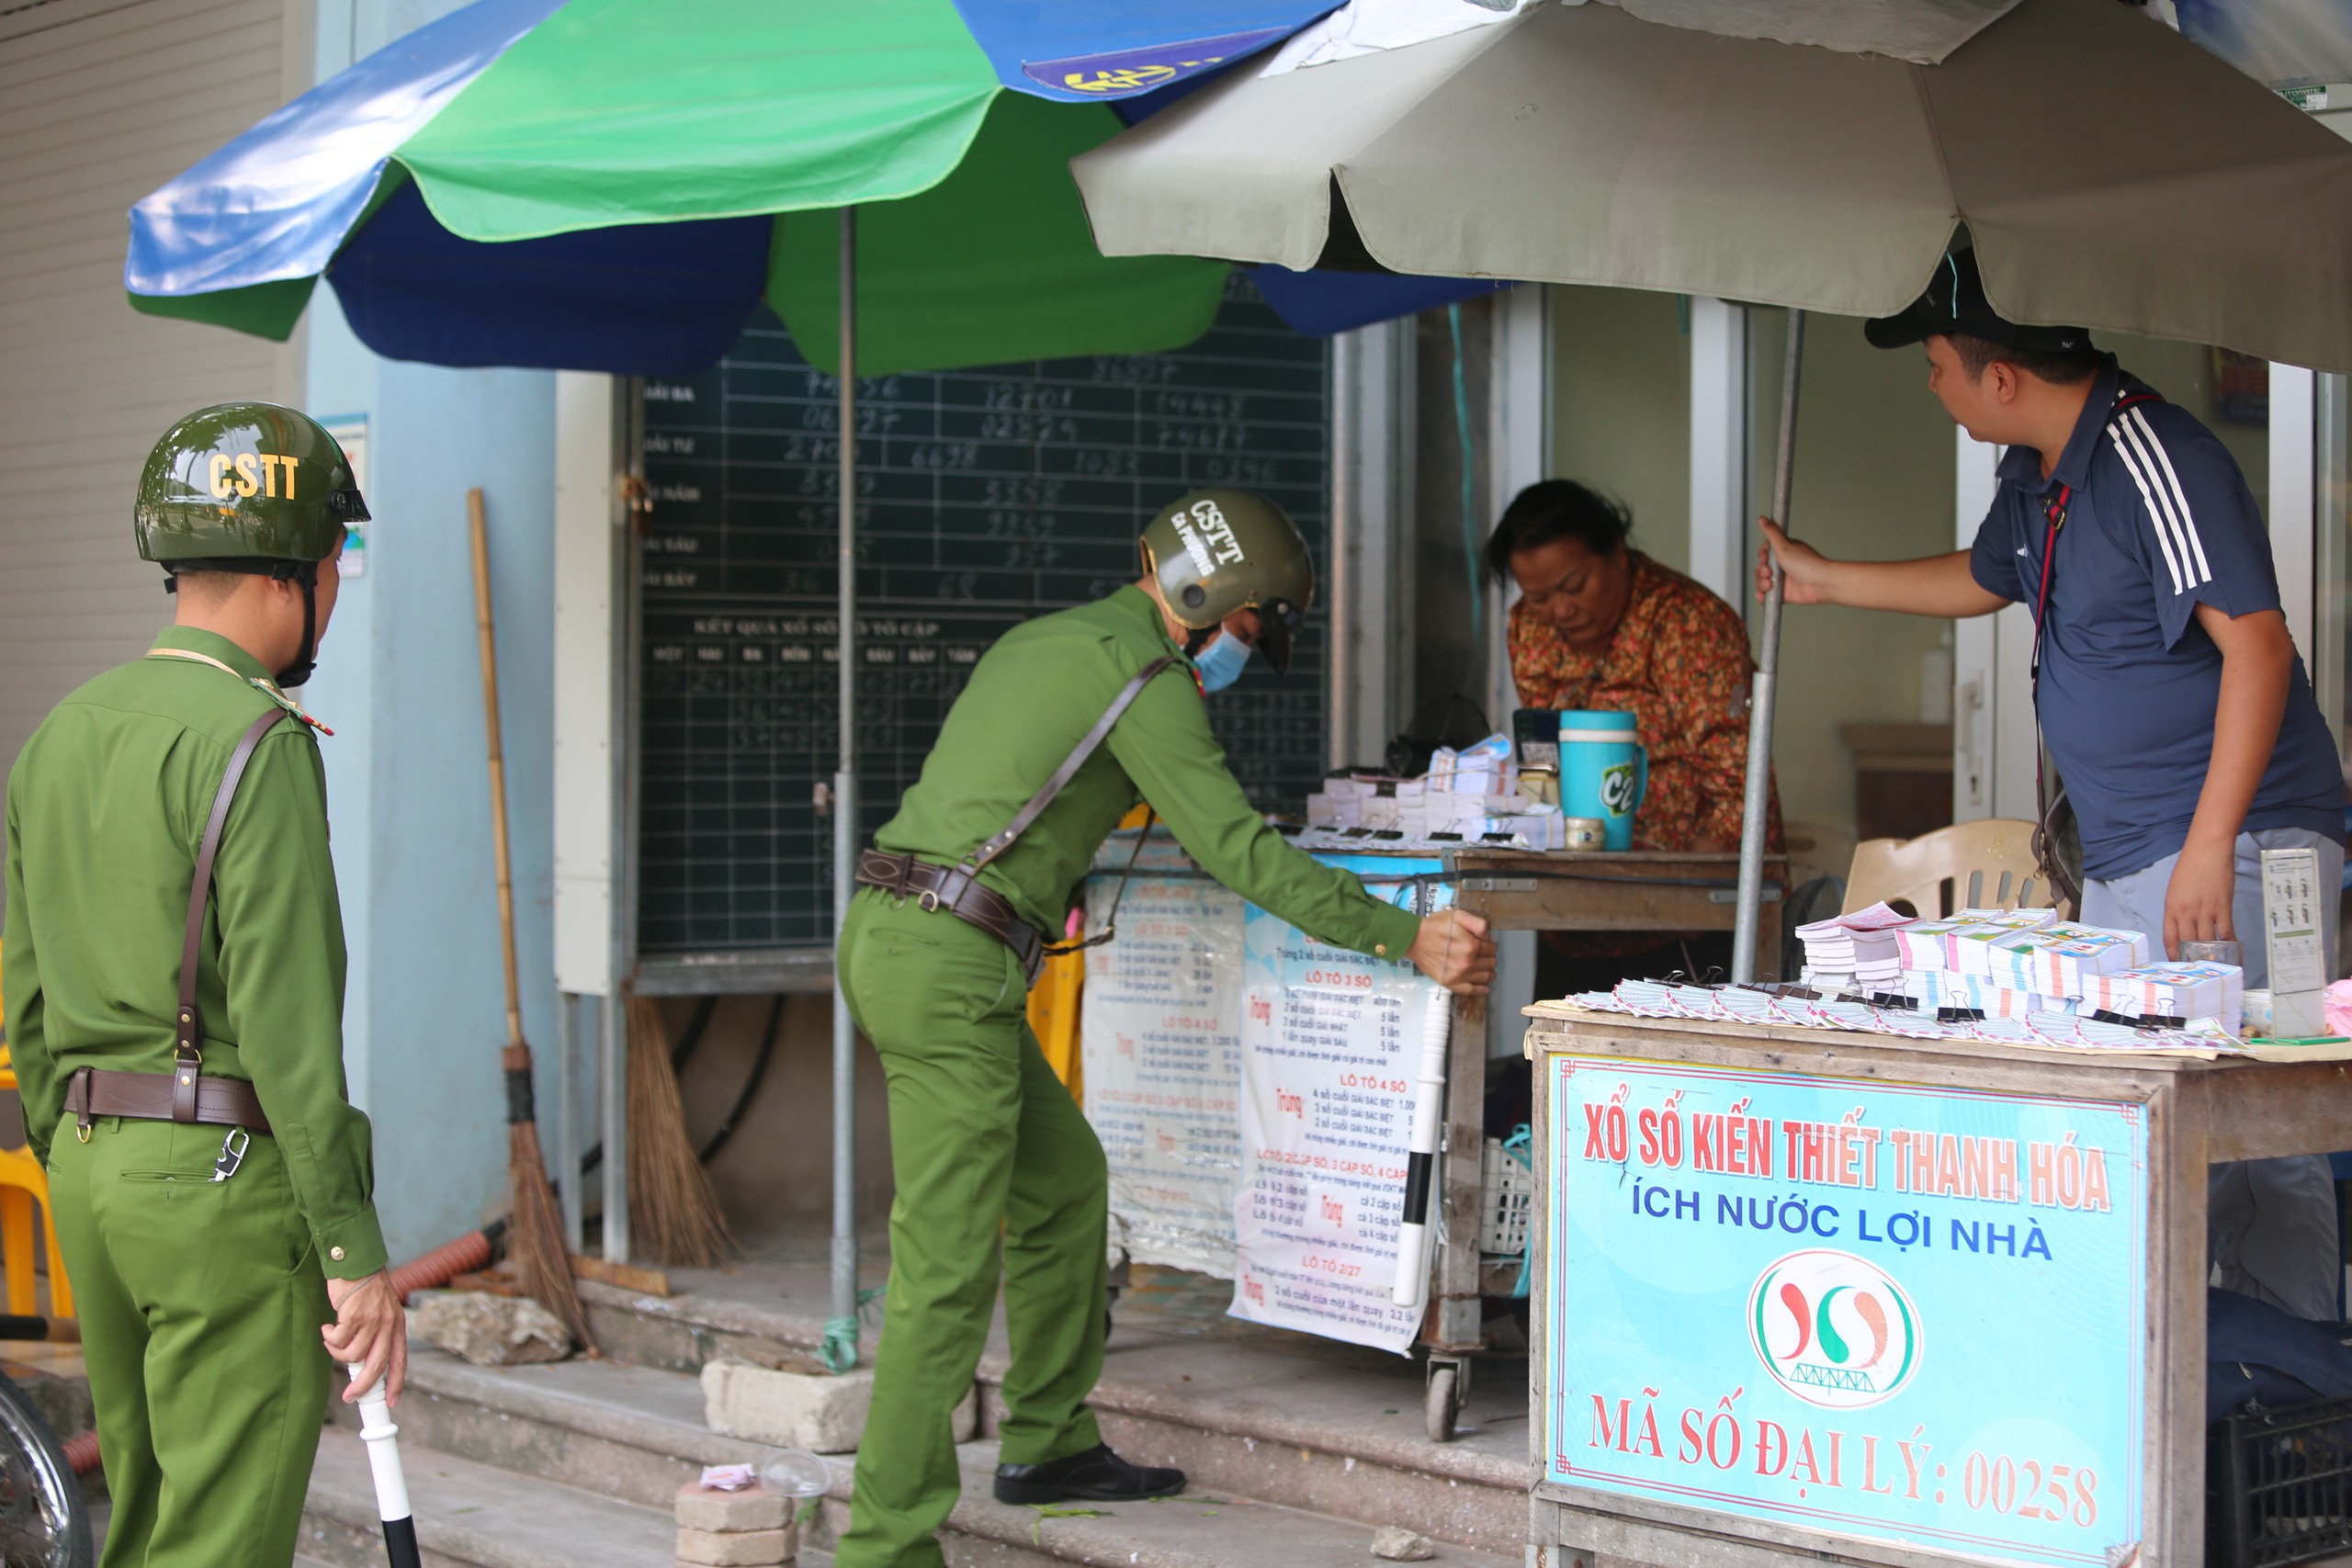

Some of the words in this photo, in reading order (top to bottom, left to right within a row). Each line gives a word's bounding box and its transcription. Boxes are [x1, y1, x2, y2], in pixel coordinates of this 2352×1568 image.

[209, 453, 299, 500] CSTT
[1191, 500, 1245, 566] CSTT
[1603, 772, 1634, 811] C2
[1306, 970, 1321, 983] LÔ
[1325, 972, 1341, 985] TÔ
[1345, 976, 1351, 986] 3
[1380, 1011, 1385, 1021] 5
[1387, 1010, 1399, 1023] lần
[1380, 1026, 1385, 1036] 5
[1387, 1025, 1399, 1038] lần
[1380, 1041, 1385, 1051] 5
[1387, 1040, 1399, 1053] lần
[1340, 1073, 1357, 1087] LÔ
[1360, 1076, 1377, 1089] TÔ
[1380, 1079, 1386, 1090] 4
[1583, 1084, 1630, 1162] XỔ
[1639, 1090, 1684, 1168] SỐ
[1693, 1098, 1773, 1180] KIẾN
[1783, 1106, 1882, 1190] THIẾT
[1891, 1126, 2020, 1203] THANH
[2030, 1131, 2112, 1213] HÓA
[1633, 1177, 1701, 1222] ÍCH
[1718, 1193, 1840, 1237] NƯỚC
[1859, 1208, 1931, 1253] LỢI
[1951, 1217, 2053, 1261] NHÀ
[1302, 1255, 1317, 1269] LÔ
[1321, 1258, 1336, 1273] TÔ
[1589, 1386, 1664, 1458] MÃ
[1679, 1386, 1744, 1471] SỐ
[1754, 1419, 1843, 1499] ĐẠI
[1963, 1451, 2098, 1529] 00258
